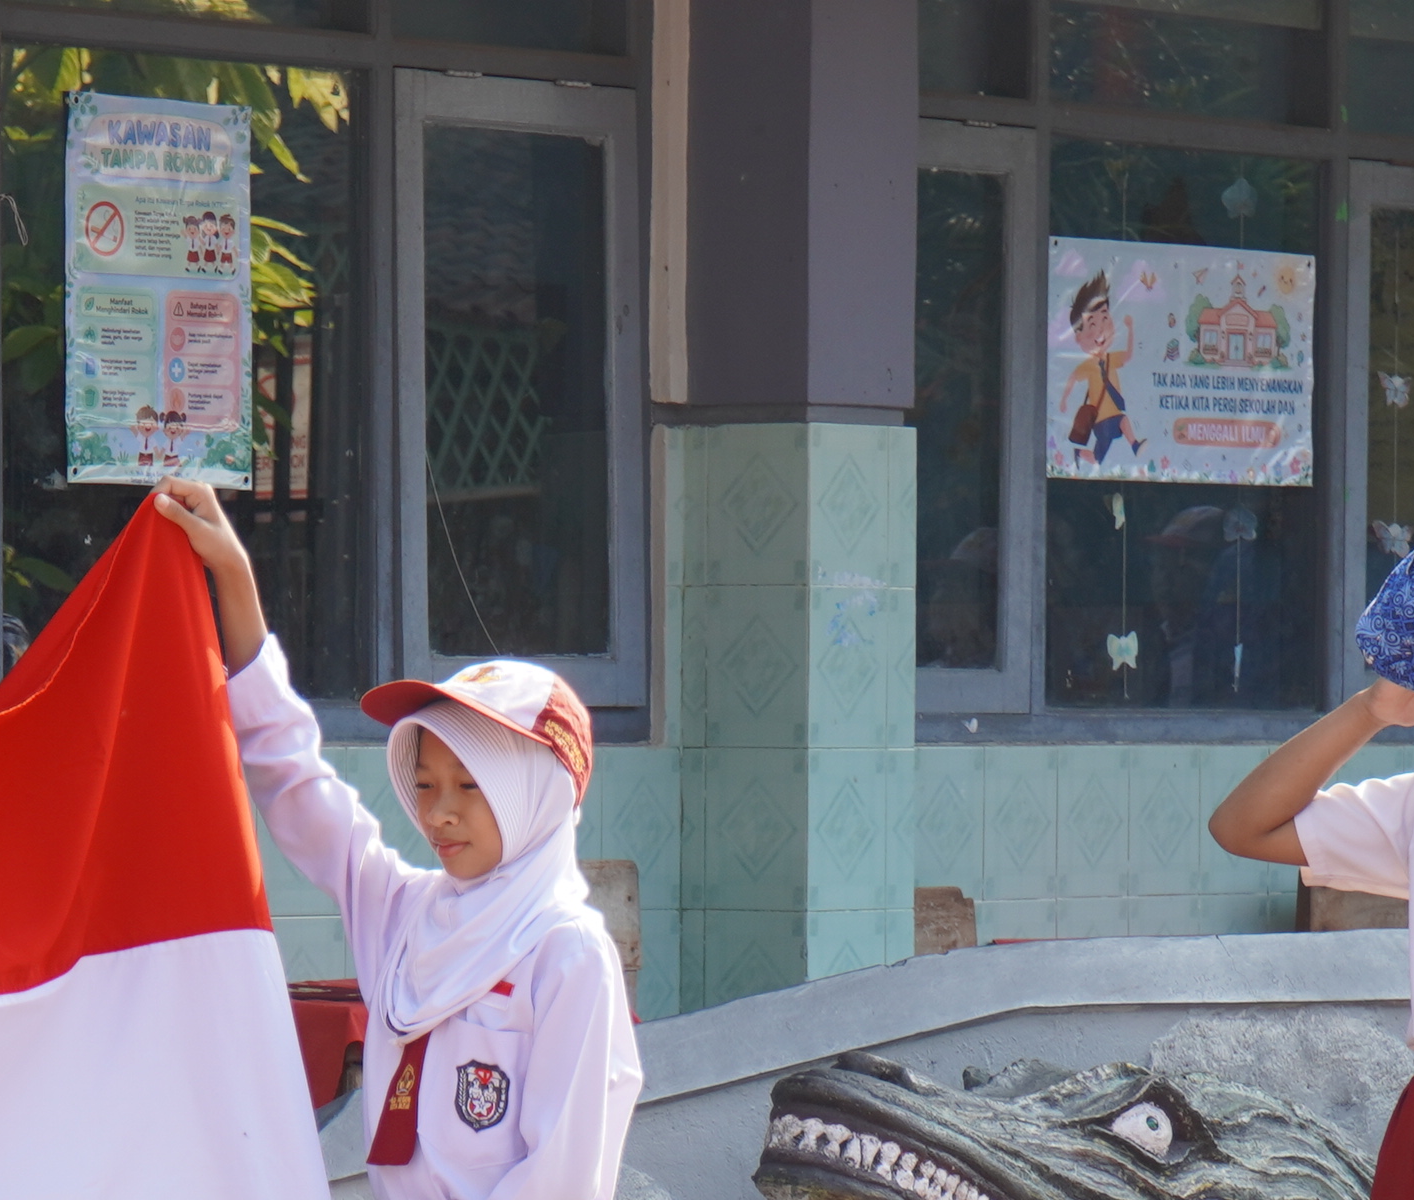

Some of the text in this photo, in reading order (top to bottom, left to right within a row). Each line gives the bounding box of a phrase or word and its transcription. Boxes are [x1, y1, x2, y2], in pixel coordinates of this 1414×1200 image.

[108, 120, 211, 151] KAWASAN
[101, 148, 218, 175] TANPA ROKOK
[110, 298, 133, 306] Manfaat
[131, 307, 148, 315] Rokok
[1152, 372, 1303, 393] TAK ADA YANG LEBIH MENYENANGKAN
[1159, 394, 1295, 415] KETIKA KITA PERGI SEKOLAH DAN
[1188, 423, 1266, 442] MENGGALI ILMU
